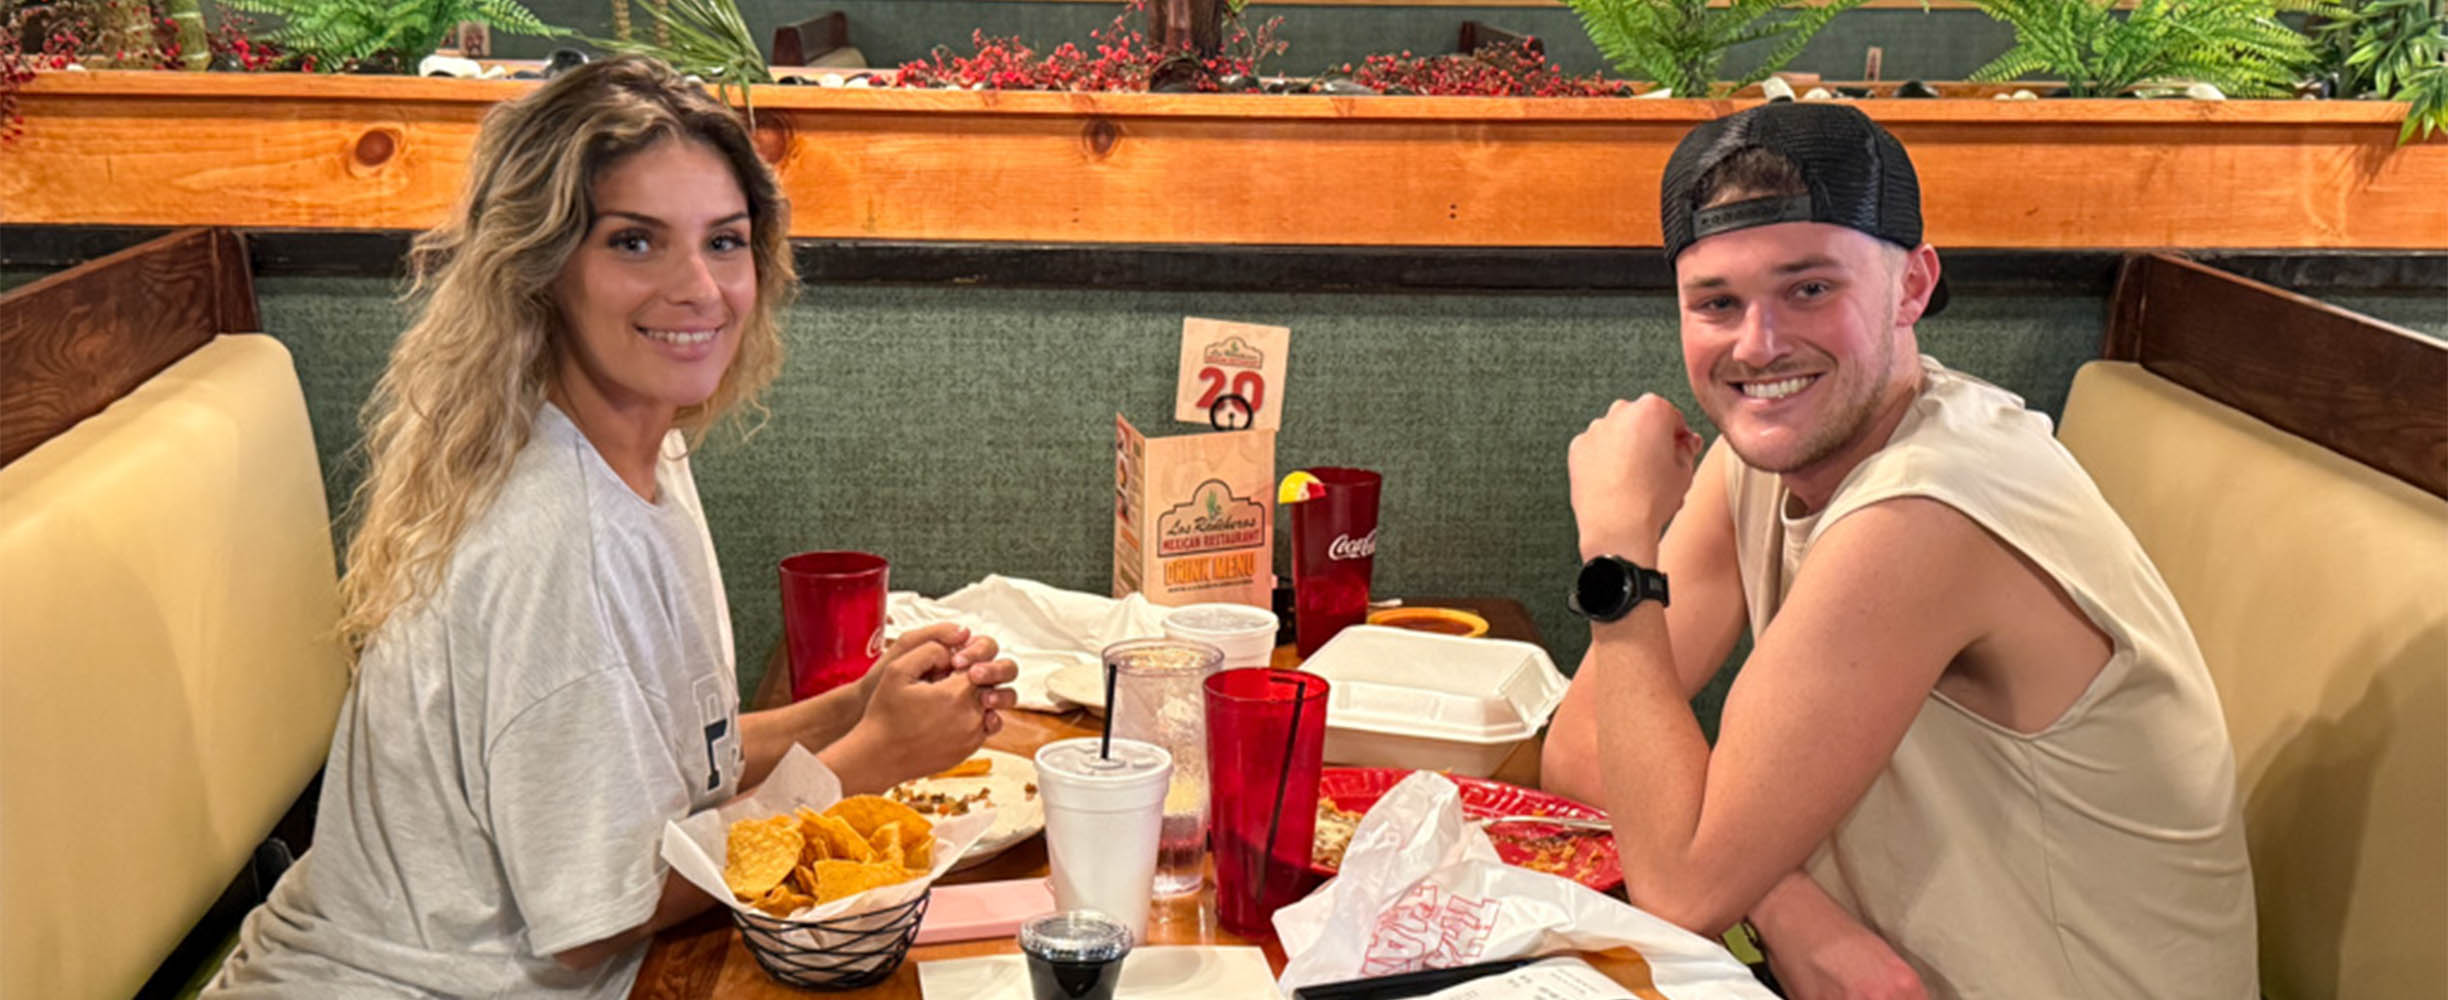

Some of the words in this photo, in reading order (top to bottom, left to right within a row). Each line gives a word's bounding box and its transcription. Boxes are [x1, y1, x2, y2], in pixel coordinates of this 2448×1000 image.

[1195, 367, 1265, 414] 20
[1163, 536, 1201, 550] MEXICAN
[1203, 529, 1259, 547] RESTAURANT
[1166, 519, 1191, 535] Los
[1164, 557, 1210, 585] DRINK
[1212, 551, 1256, 579] MENU
